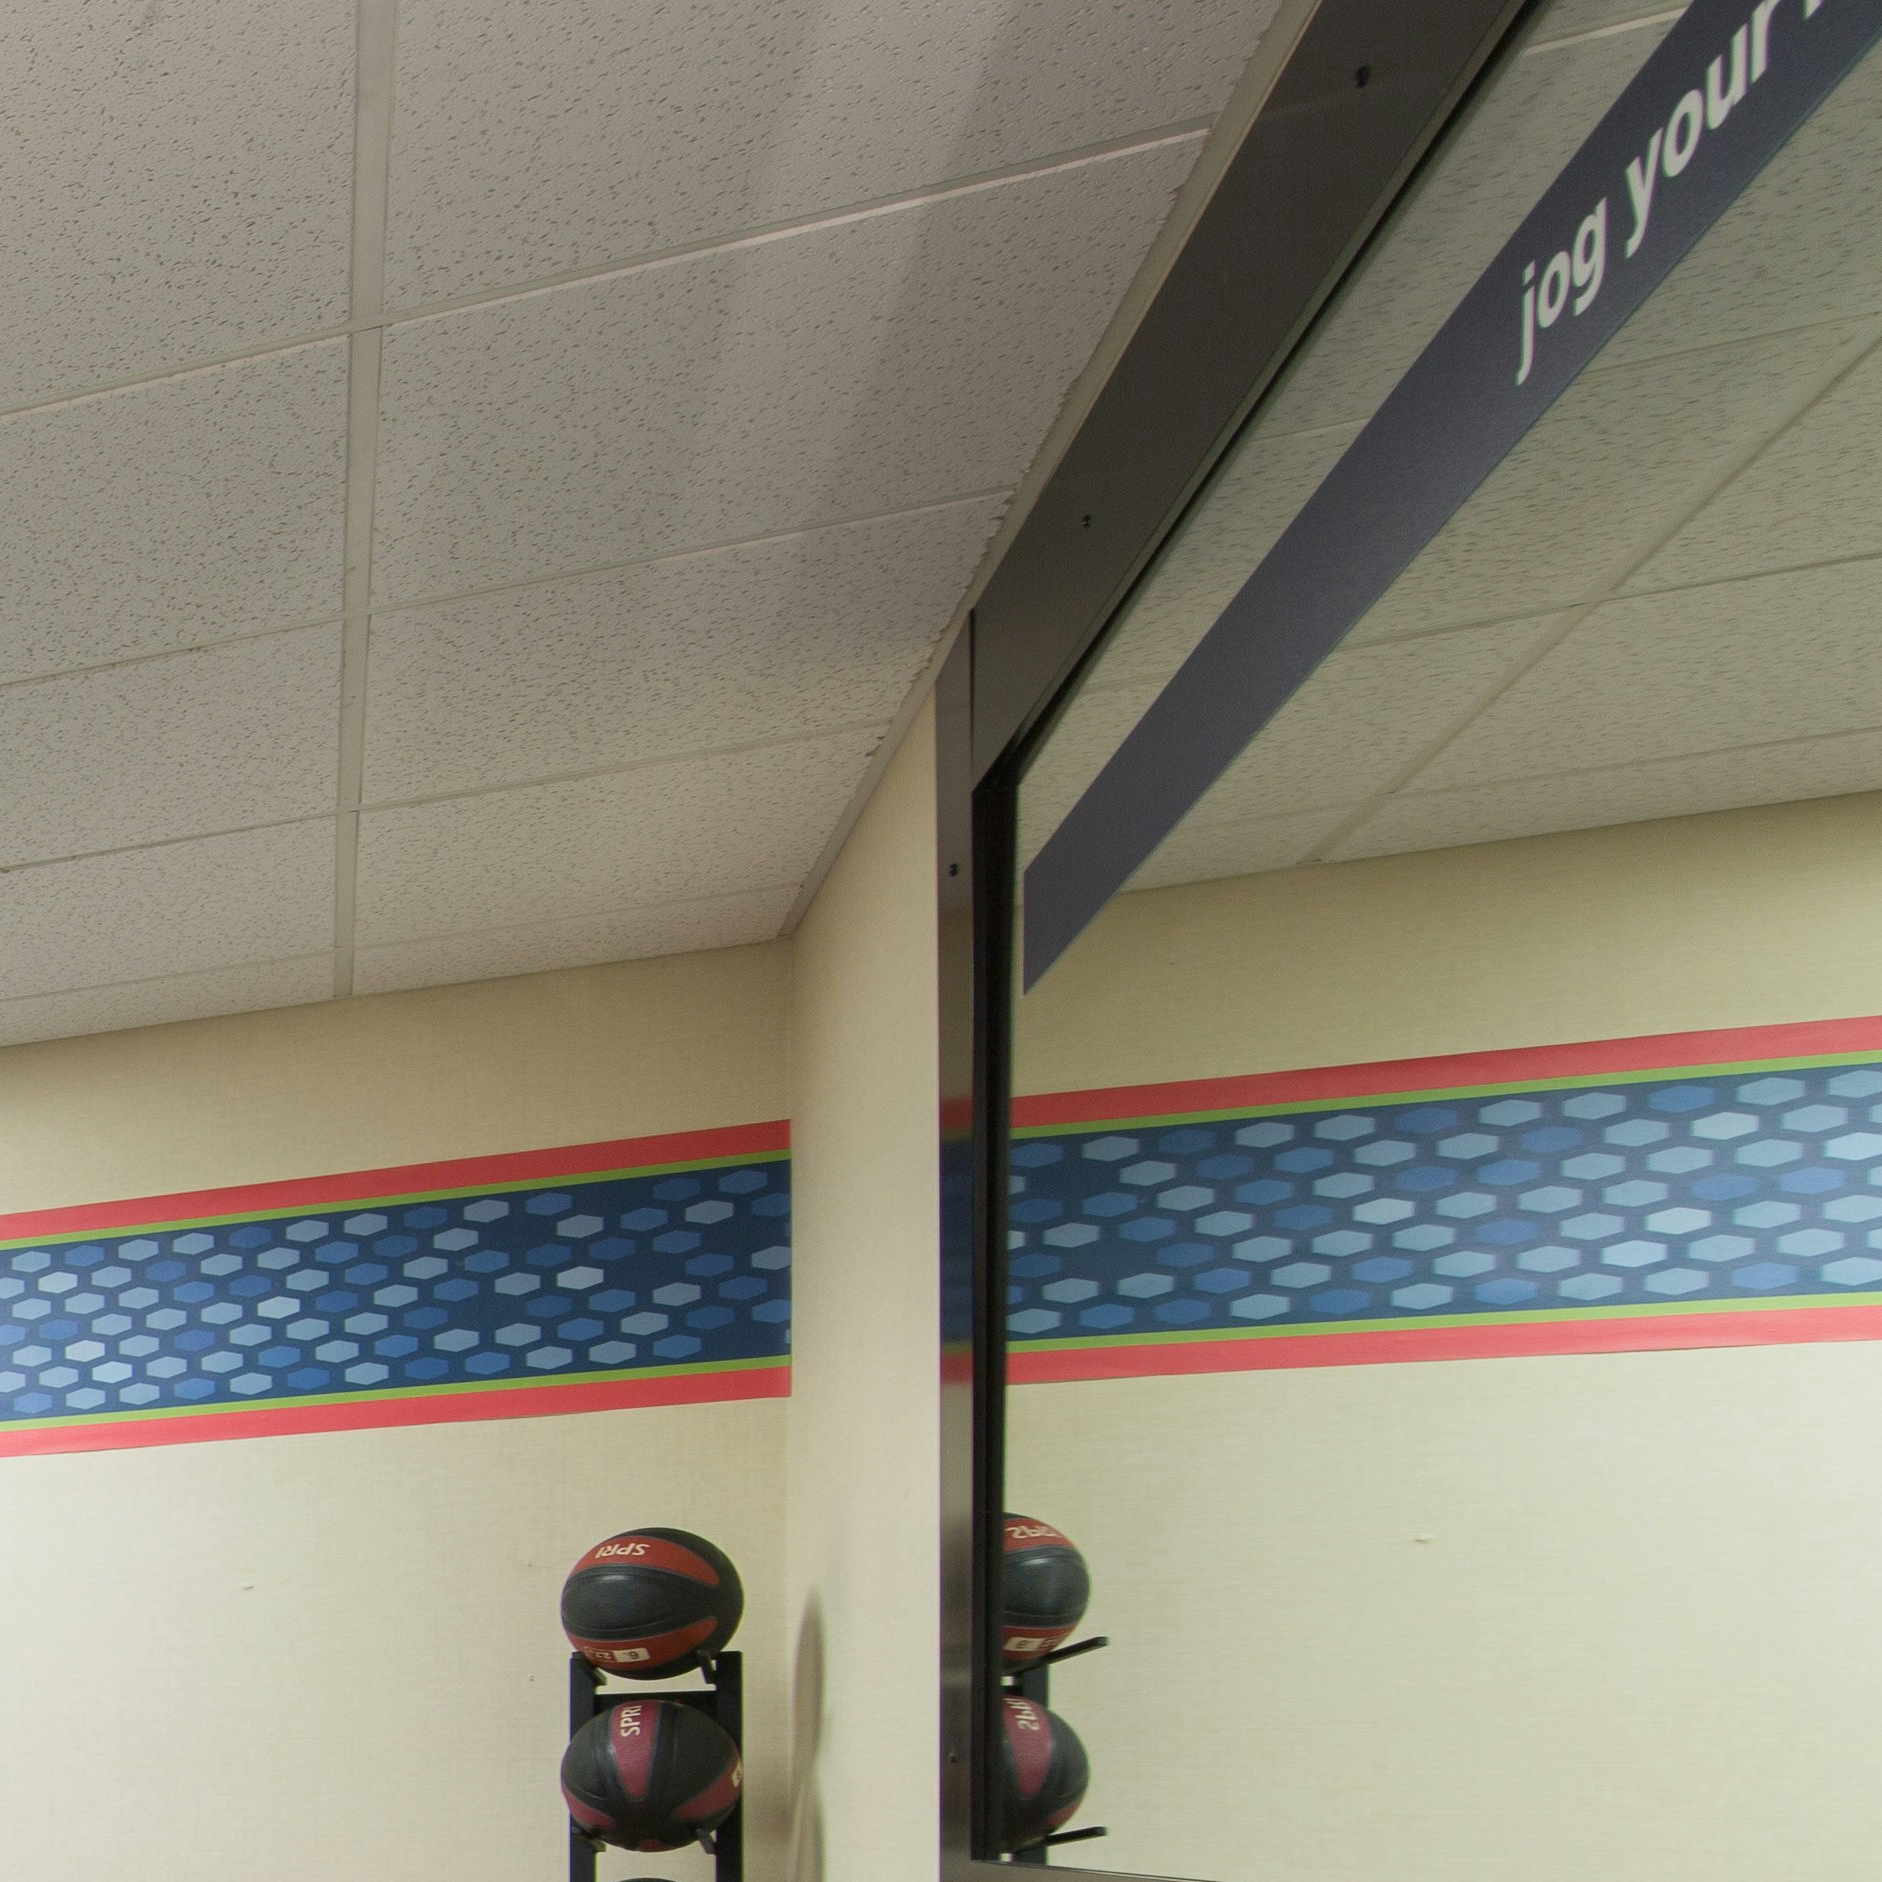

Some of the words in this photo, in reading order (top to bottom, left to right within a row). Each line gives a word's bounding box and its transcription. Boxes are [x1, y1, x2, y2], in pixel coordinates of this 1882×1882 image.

[1515, 197, 1608, 386] jog
[1624, 0, 1784, 259] your
[595, 1542, 650, 1559] SPRI
[620, 1704, 643, 1737] SPRI
